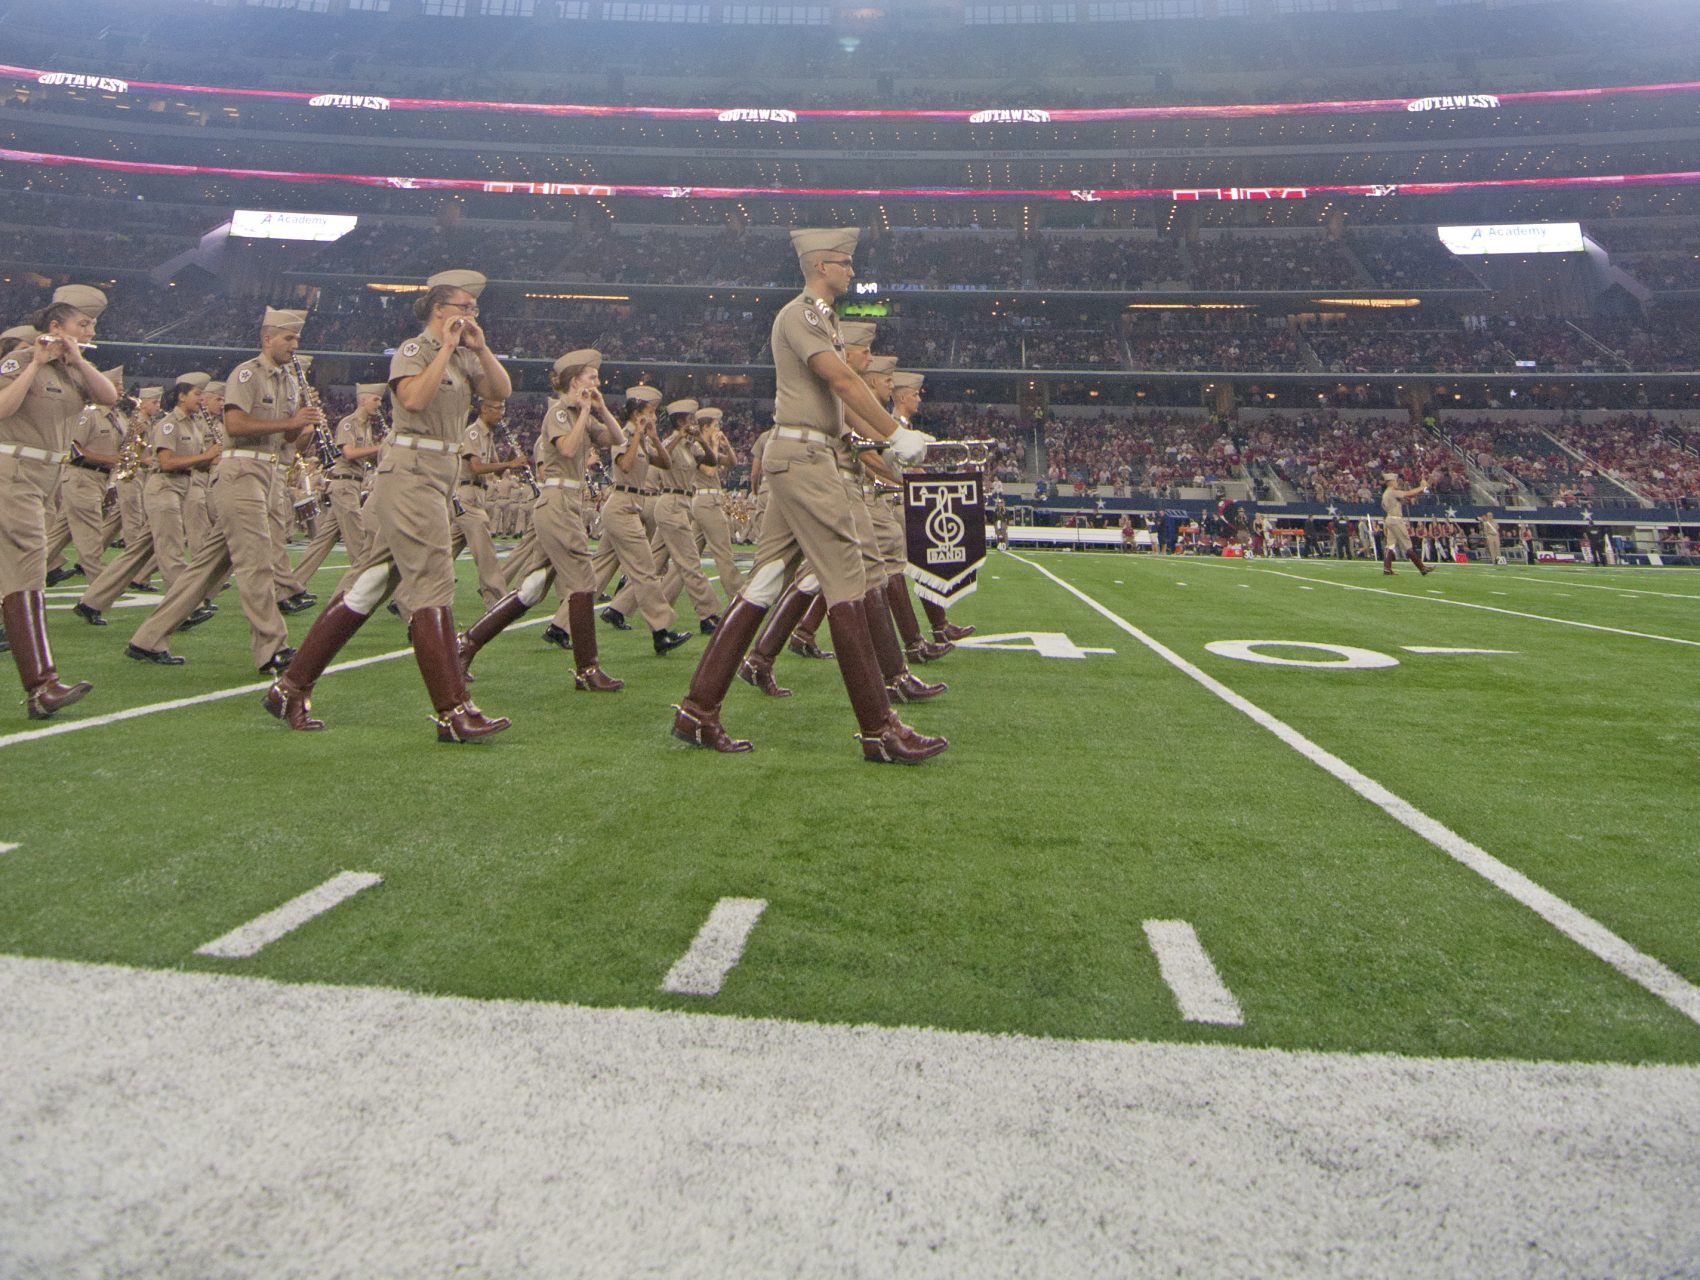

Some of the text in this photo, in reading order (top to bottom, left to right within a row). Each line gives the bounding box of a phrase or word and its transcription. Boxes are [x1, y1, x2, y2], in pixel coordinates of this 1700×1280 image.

[277, 214, 327, 225] Academy
[1488, 227, 1547, 236] Academy
[929, 550, 963, 561] BAND
